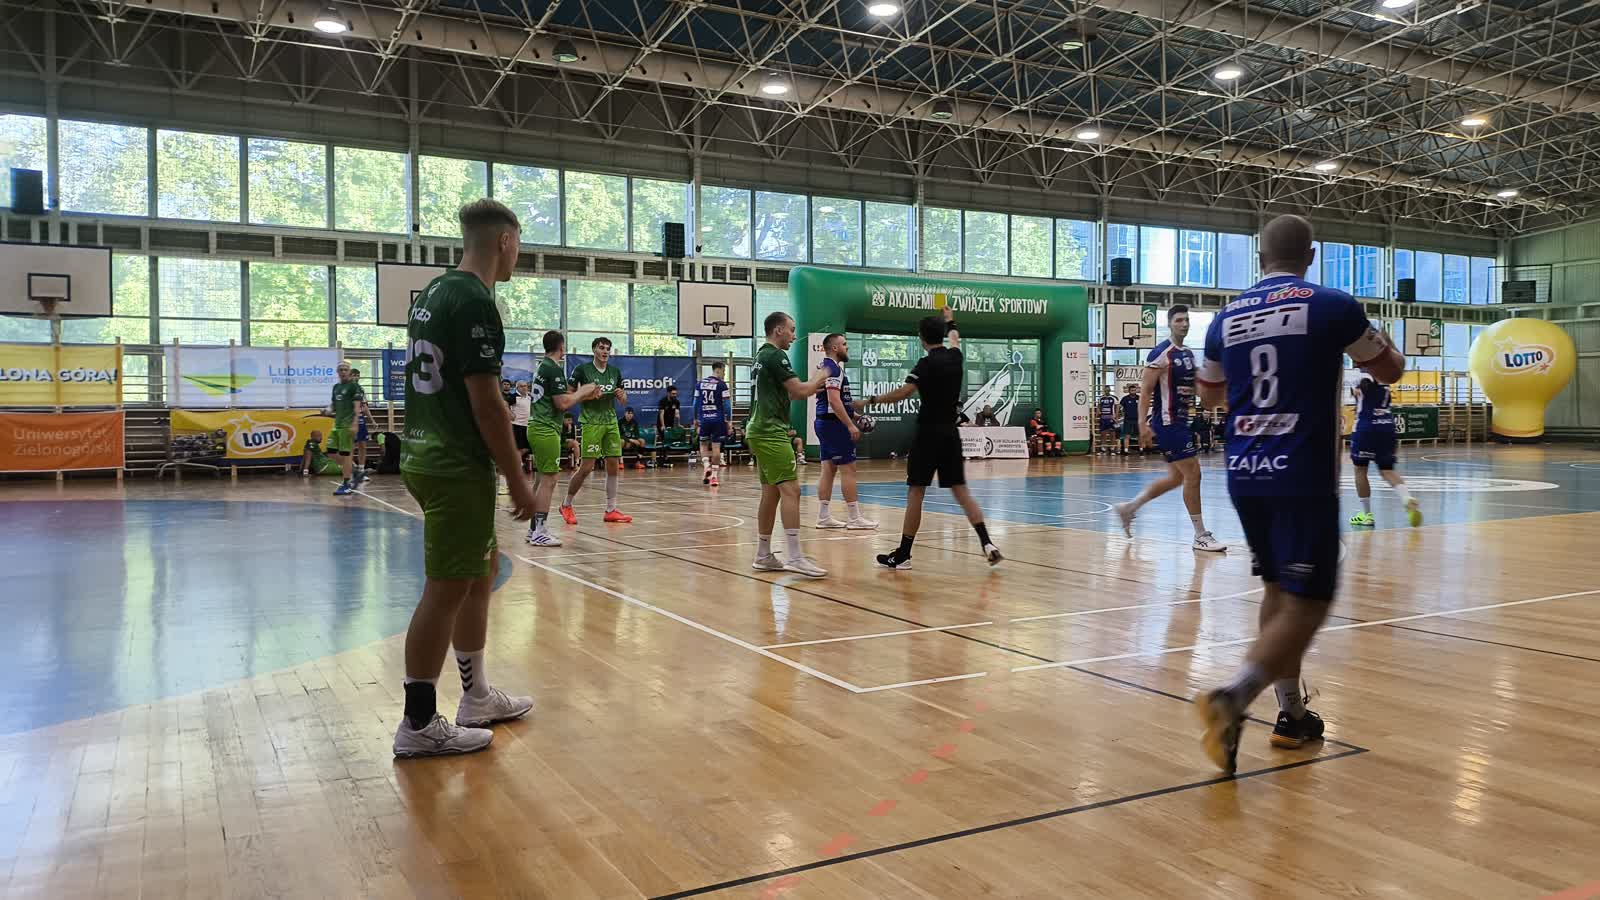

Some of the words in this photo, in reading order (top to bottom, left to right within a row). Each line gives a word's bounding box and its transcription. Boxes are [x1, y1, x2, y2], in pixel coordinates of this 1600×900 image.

[888, 291, 948, 310] AKADEMII
[952, 295, 996, 315] ZWIĄZEK
[999, 298, 1048, 315] SPORTOWY
[1504, 350, 1543, 368] LOTTO
[0, 367, 53, 382] LONA
[268, 365, 334, 377] Lubuskie
[1251, 344, 1279, 408] 8
[622, 376, 673, 389] amsoft
[702, 390, 715, 404] 34
[14, 427, 113, 444] Uniwersytet
[242, 428, 282, 447] LOTTO
[587, 444, 600, 453] 29
[1228, 454, 1289, 474] ZAJĄC
